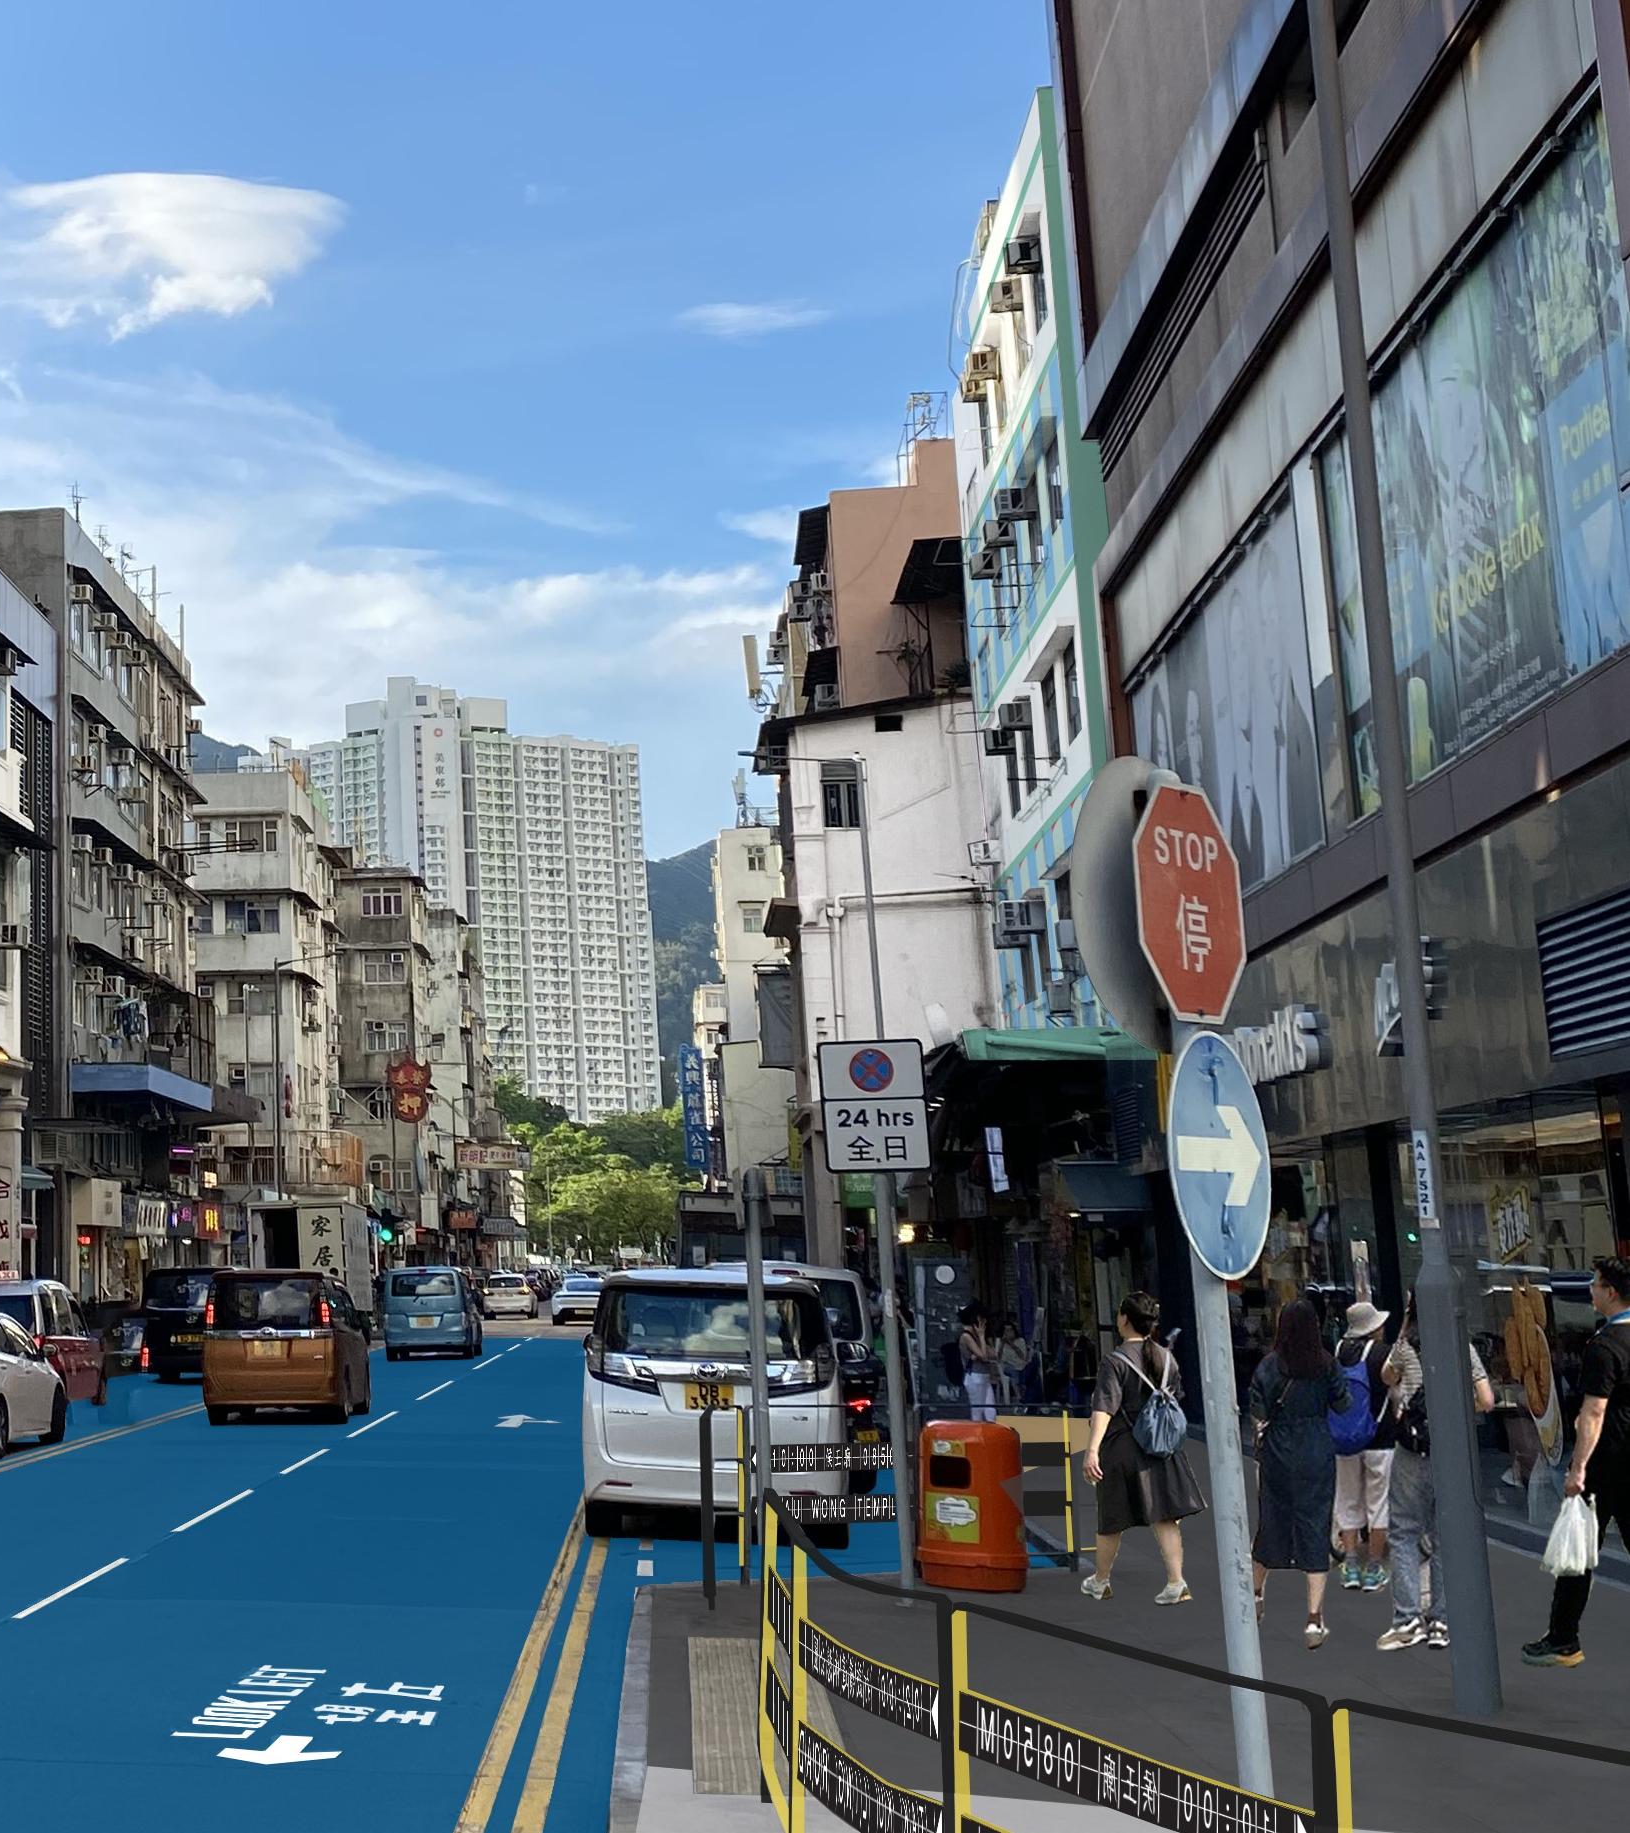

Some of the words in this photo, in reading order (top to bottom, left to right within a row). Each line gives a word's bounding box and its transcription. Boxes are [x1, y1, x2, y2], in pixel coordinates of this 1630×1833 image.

[1154, 825, 1218, 873] STOP
[1176, 893, 1212, 973] 停
[398, 1093, 421, 1116] 押
[837, 1109, 869, 1128] 24
[877, 1108, 914, 1127] hrs
[847, 1136, 907, 1162] 全日
[1418, 1168, 1429, 1216] 7521
[811, 1499, 846, 1519] WONG
[226, 1665, 327, 1697] LEFT
[170, 1695, 292, 1739] LOOK
